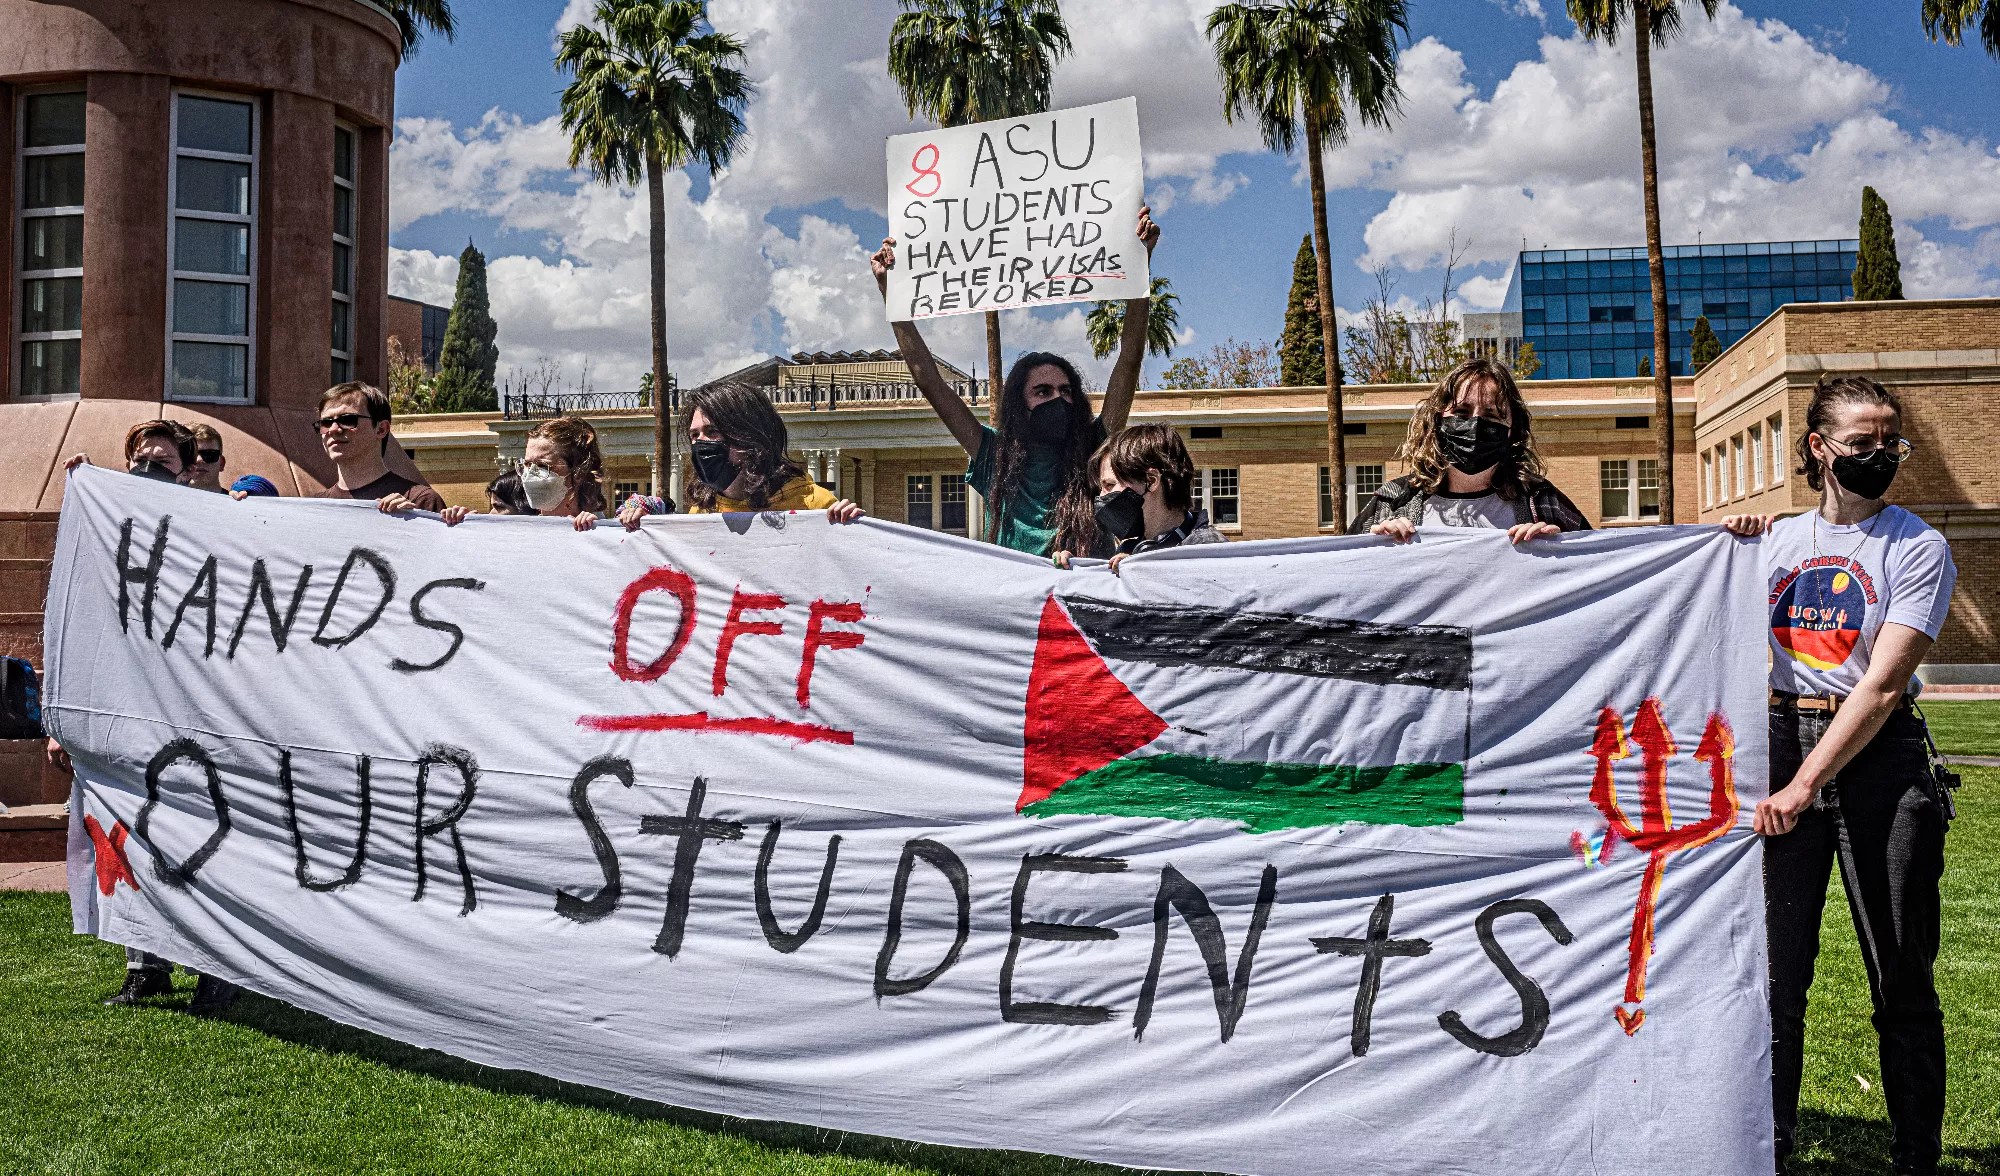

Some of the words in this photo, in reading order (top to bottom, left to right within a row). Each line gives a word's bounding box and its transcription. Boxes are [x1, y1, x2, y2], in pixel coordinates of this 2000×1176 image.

[905, 142, 941, 198] 8
[969, 117, 1095, 190] ASU
[903, 179, 1113, 239] STUDENTS
[907, 226, 1010, 270] HAVE
[1026, 220, 1102, 252] HAD
[910, 276, 1094, 317] REVOKED
[911, 256, 1034, 298] THEIR
[1801, 555, 1851, 571] Campus
[114, 514, 487, 674] HANDS
[607, 564, 867, 709] OFF
[1787, 605, 1837, 622] UCW
[135, 736, 481, 918] OUR
